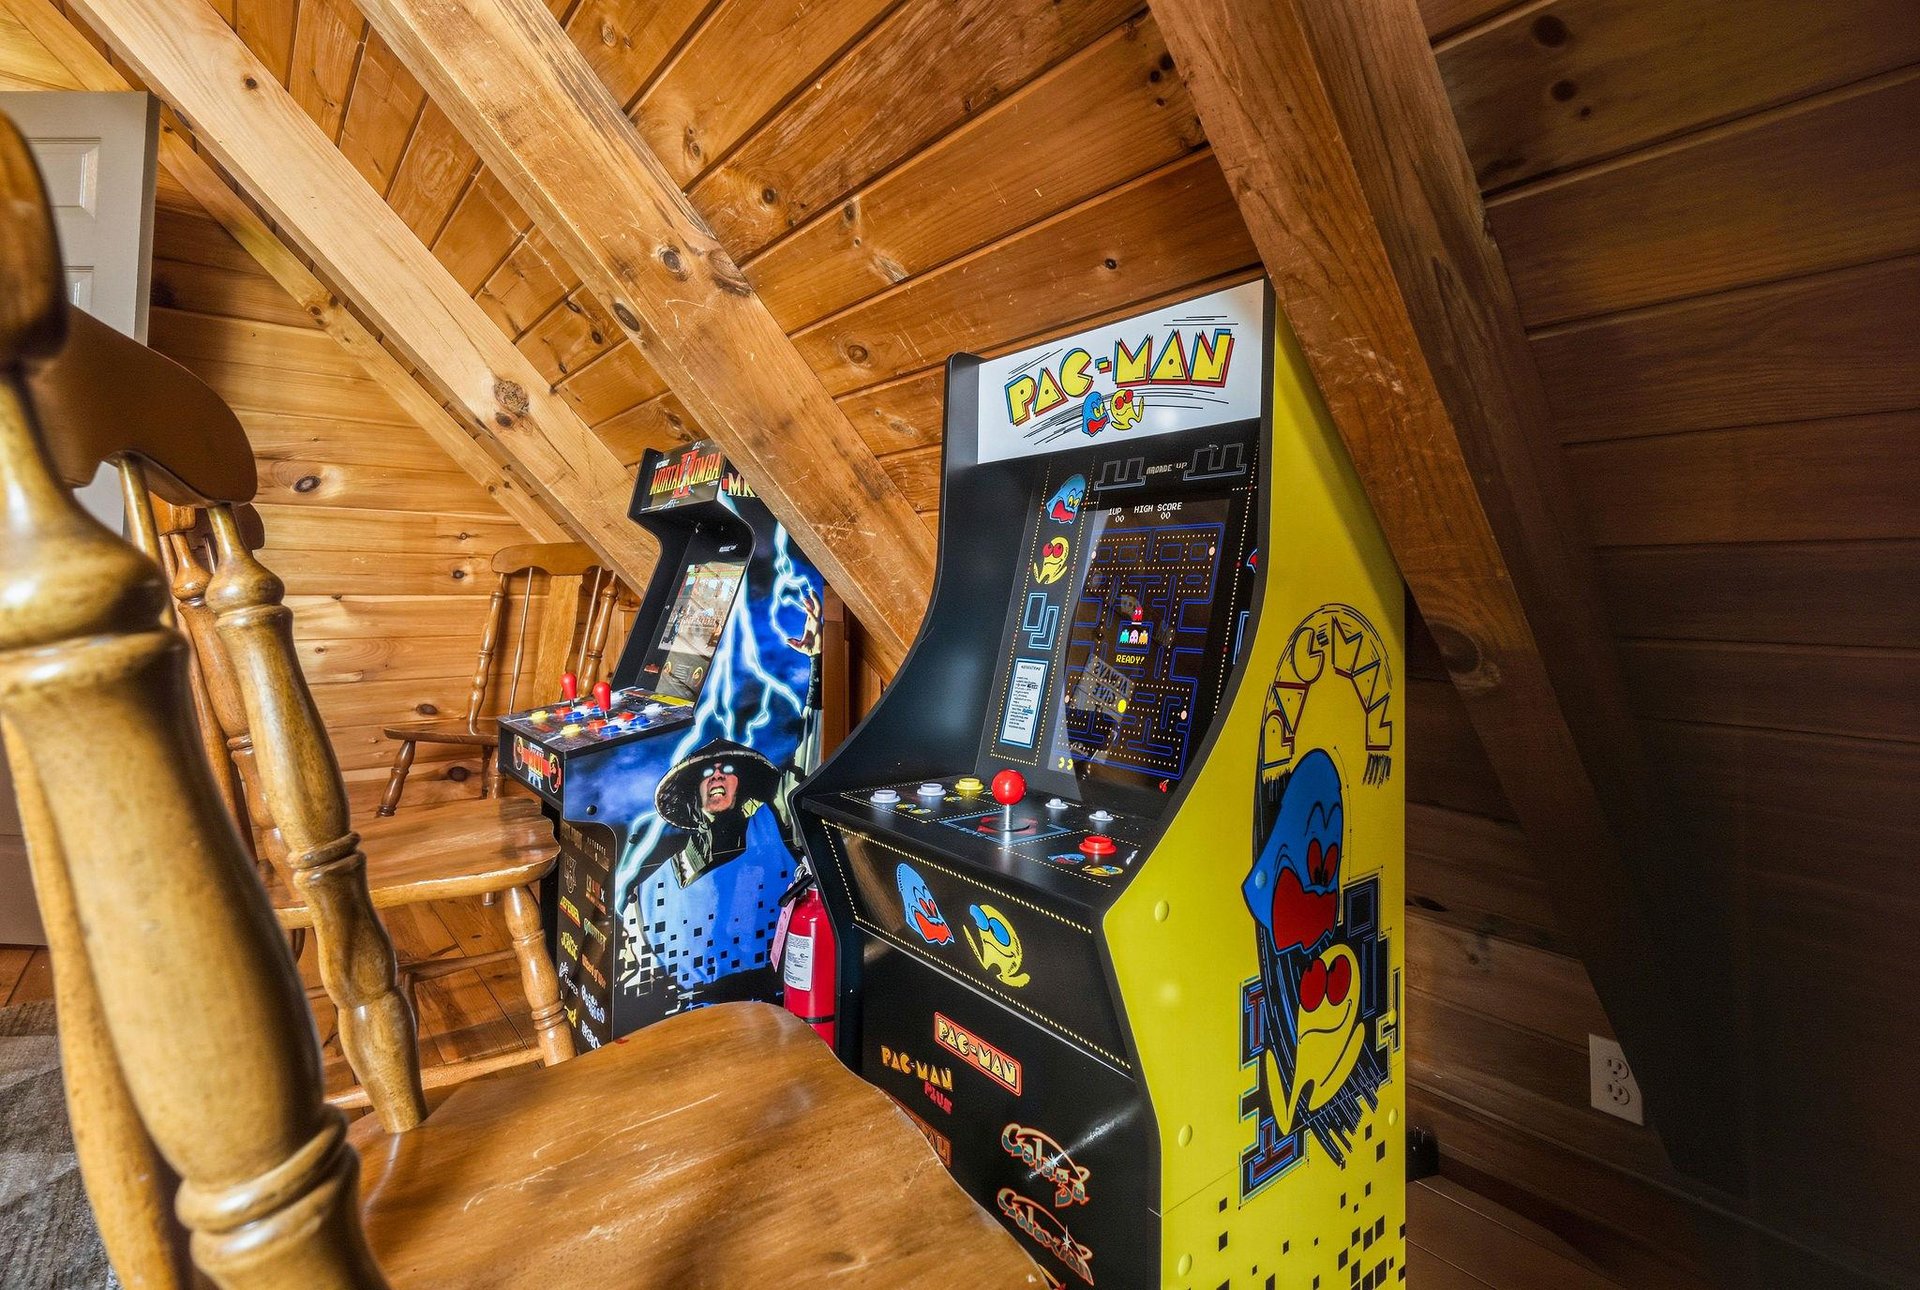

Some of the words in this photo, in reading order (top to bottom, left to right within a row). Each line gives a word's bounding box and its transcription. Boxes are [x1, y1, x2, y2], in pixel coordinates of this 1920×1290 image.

[1004, 329, 1235, 426] PAC-MAN
[684, 451, 722, 488] KOMBA
[1108, 506, 1122, 516] 1UP
[1115, 514, 1125, 523] 00
[1134, 504, 1153, 514] HIGH
[1157, 502, 1182, 512] SCORE
[1160, 511, 1171, 520] 00
[1116, 654, 1145, 665] READY!
[1262, 615, 1392, 769] PAC-MAN
[937, 1017, 1017, 1089] PAC-MAN
[881, 1045, 953, 1092] PAC-MAN
